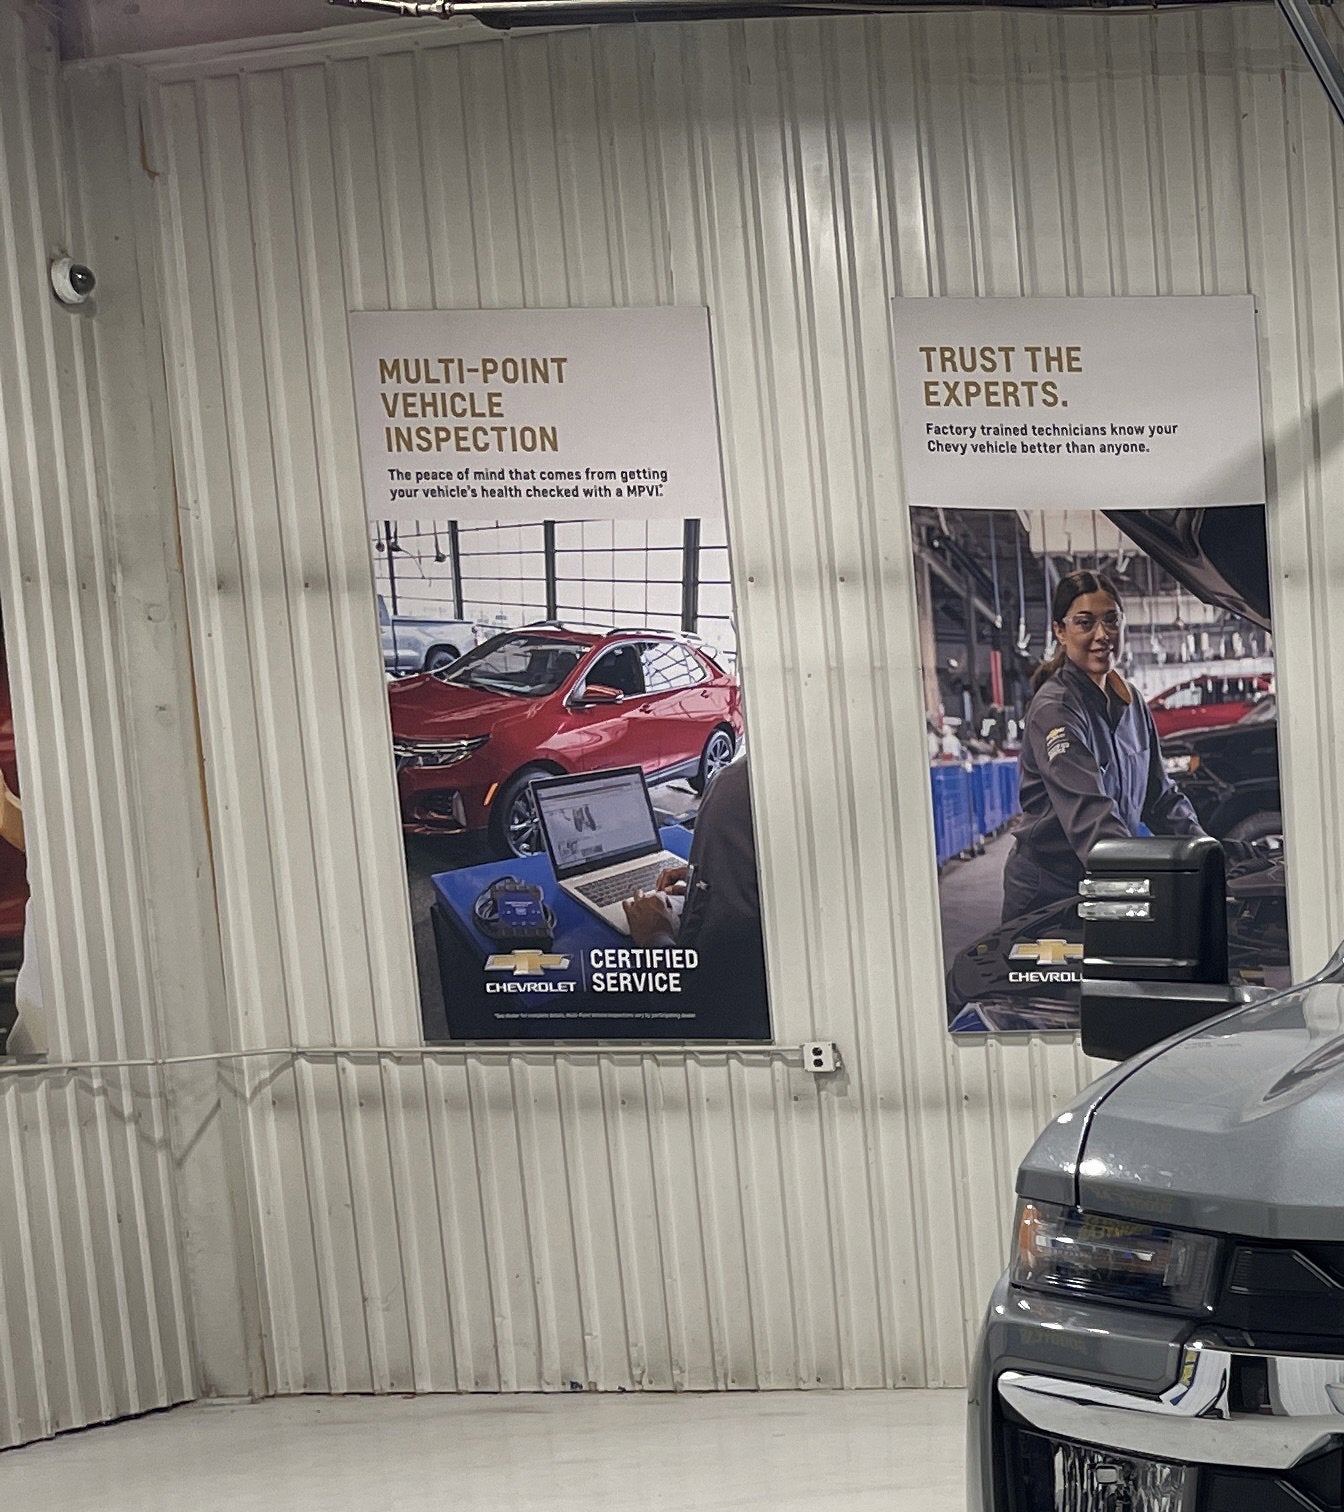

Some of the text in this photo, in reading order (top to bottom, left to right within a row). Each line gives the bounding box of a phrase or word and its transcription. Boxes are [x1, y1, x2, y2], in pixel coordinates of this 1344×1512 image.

[919, 346, 1083, 373] TRUST THE
[378, 357, 568, 385] MULTI-POINT
[923, 381, 1069, 408] EXPERTS.
[380, 392, 505, 419] VEHICLE
[385, 426, 559, 453] INSPECTION
[926, 423, 1178, 438] Factory trained technicians know your
[927, 440, 1150, 456] Chevy vehicle better than anyone.
[388, 468, 668, 484] The peace of mind that comes from getting
[390, 488, 419, 501] your
[422, 485, 478, 498] vehicle's
[481, 485, 522, 498] health
[525, 485, 579, 498] checked
[583, 485, 611, 498] with
[616, 488, 623, 498] a
[590, 949, 699, 969] CERTIFIED
[486, 981, 577, 993] CHEVROLET
[592, 972, 682, 992] SERVICE
[1008, 971, 1084, 983] CHEVROL
